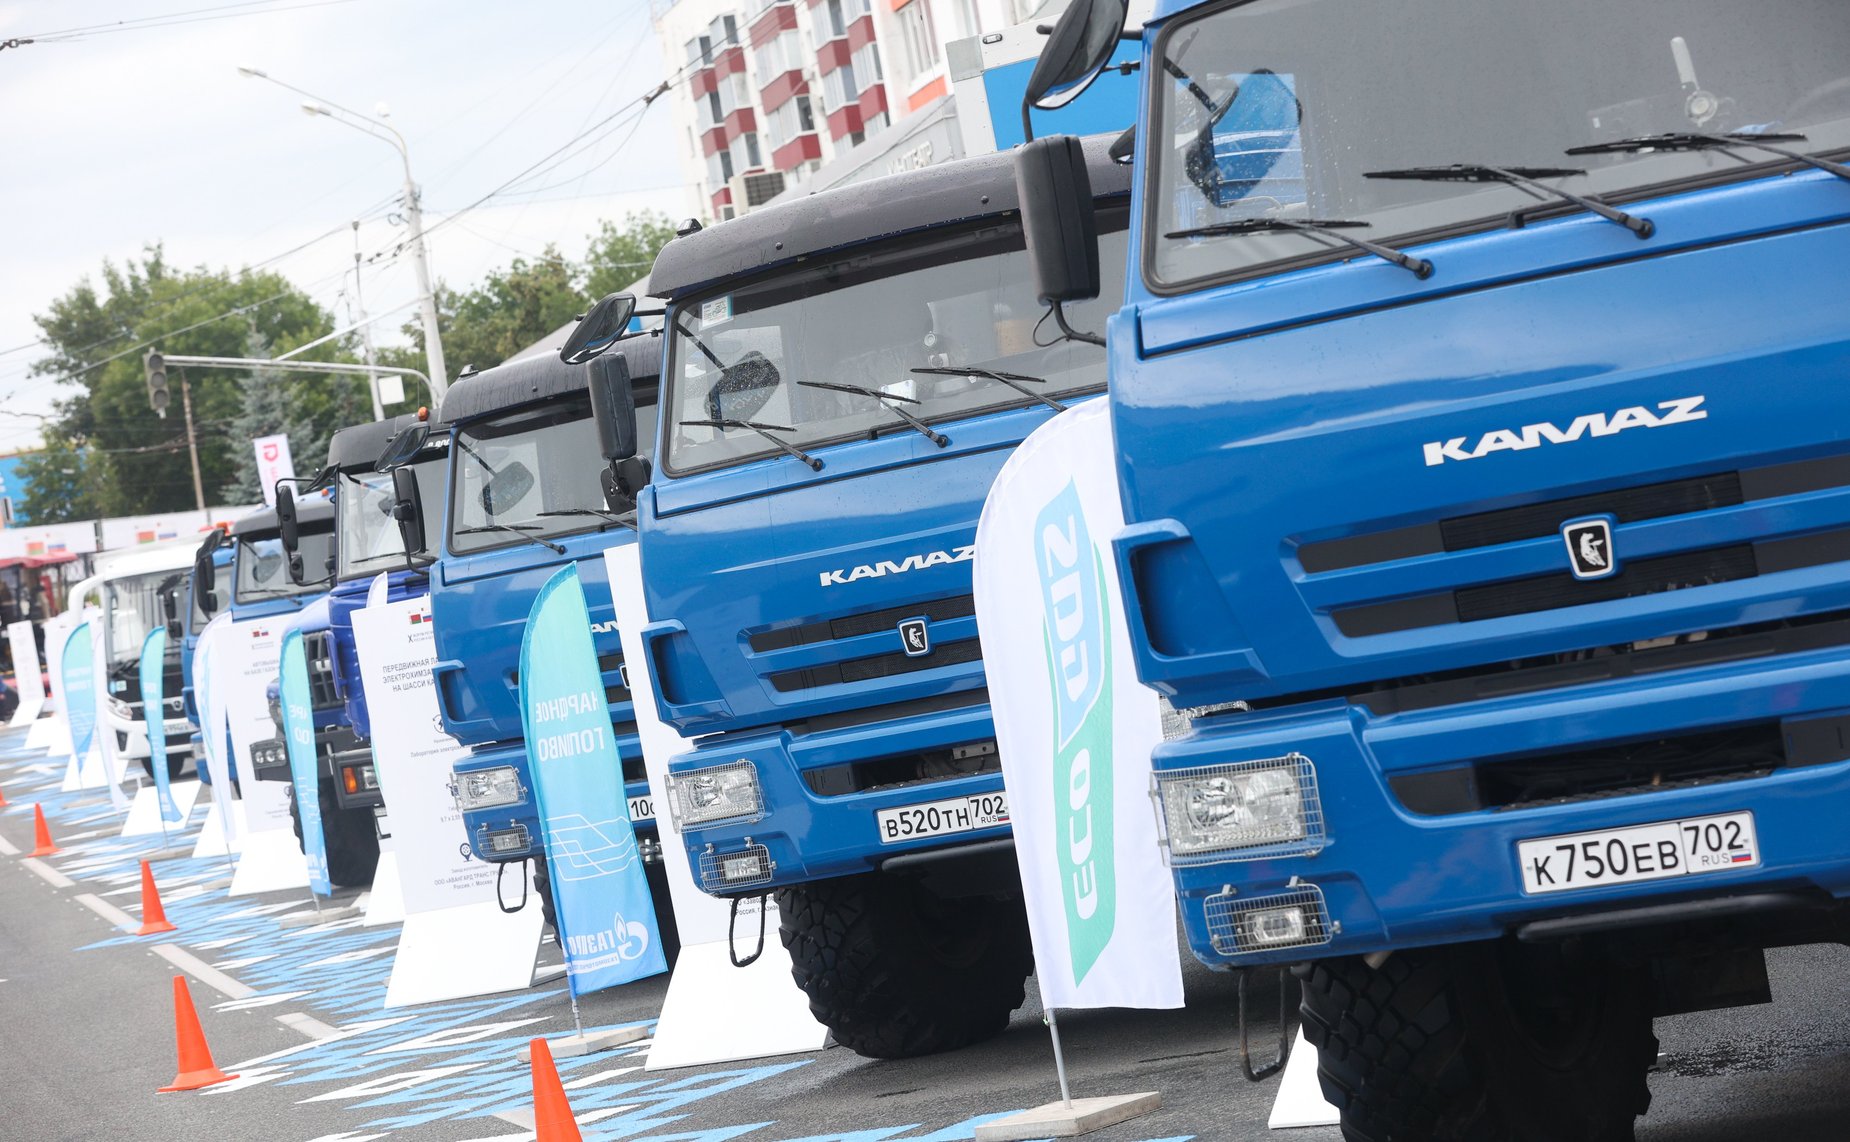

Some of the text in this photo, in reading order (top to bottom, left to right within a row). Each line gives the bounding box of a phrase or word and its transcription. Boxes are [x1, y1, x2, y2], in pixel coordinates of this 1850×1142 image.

[1422, 395, 1708, 467] KAMAZ
[820, 545, 975, 587] KAMAZ
[382, 658, 430, 673] ПЕРЕДВИЖНАЯ
[382, 668, 433, 684] ЭЛЕКТРОХИМЗА
[403, 681, 426, 691] ШАССИ
[970, 796, 1005, 819] 702
[980, 815, 998, 824] RUS
[1683, 820, 1743, 856] 702
[1701, 852, 1730, 866] RUS
